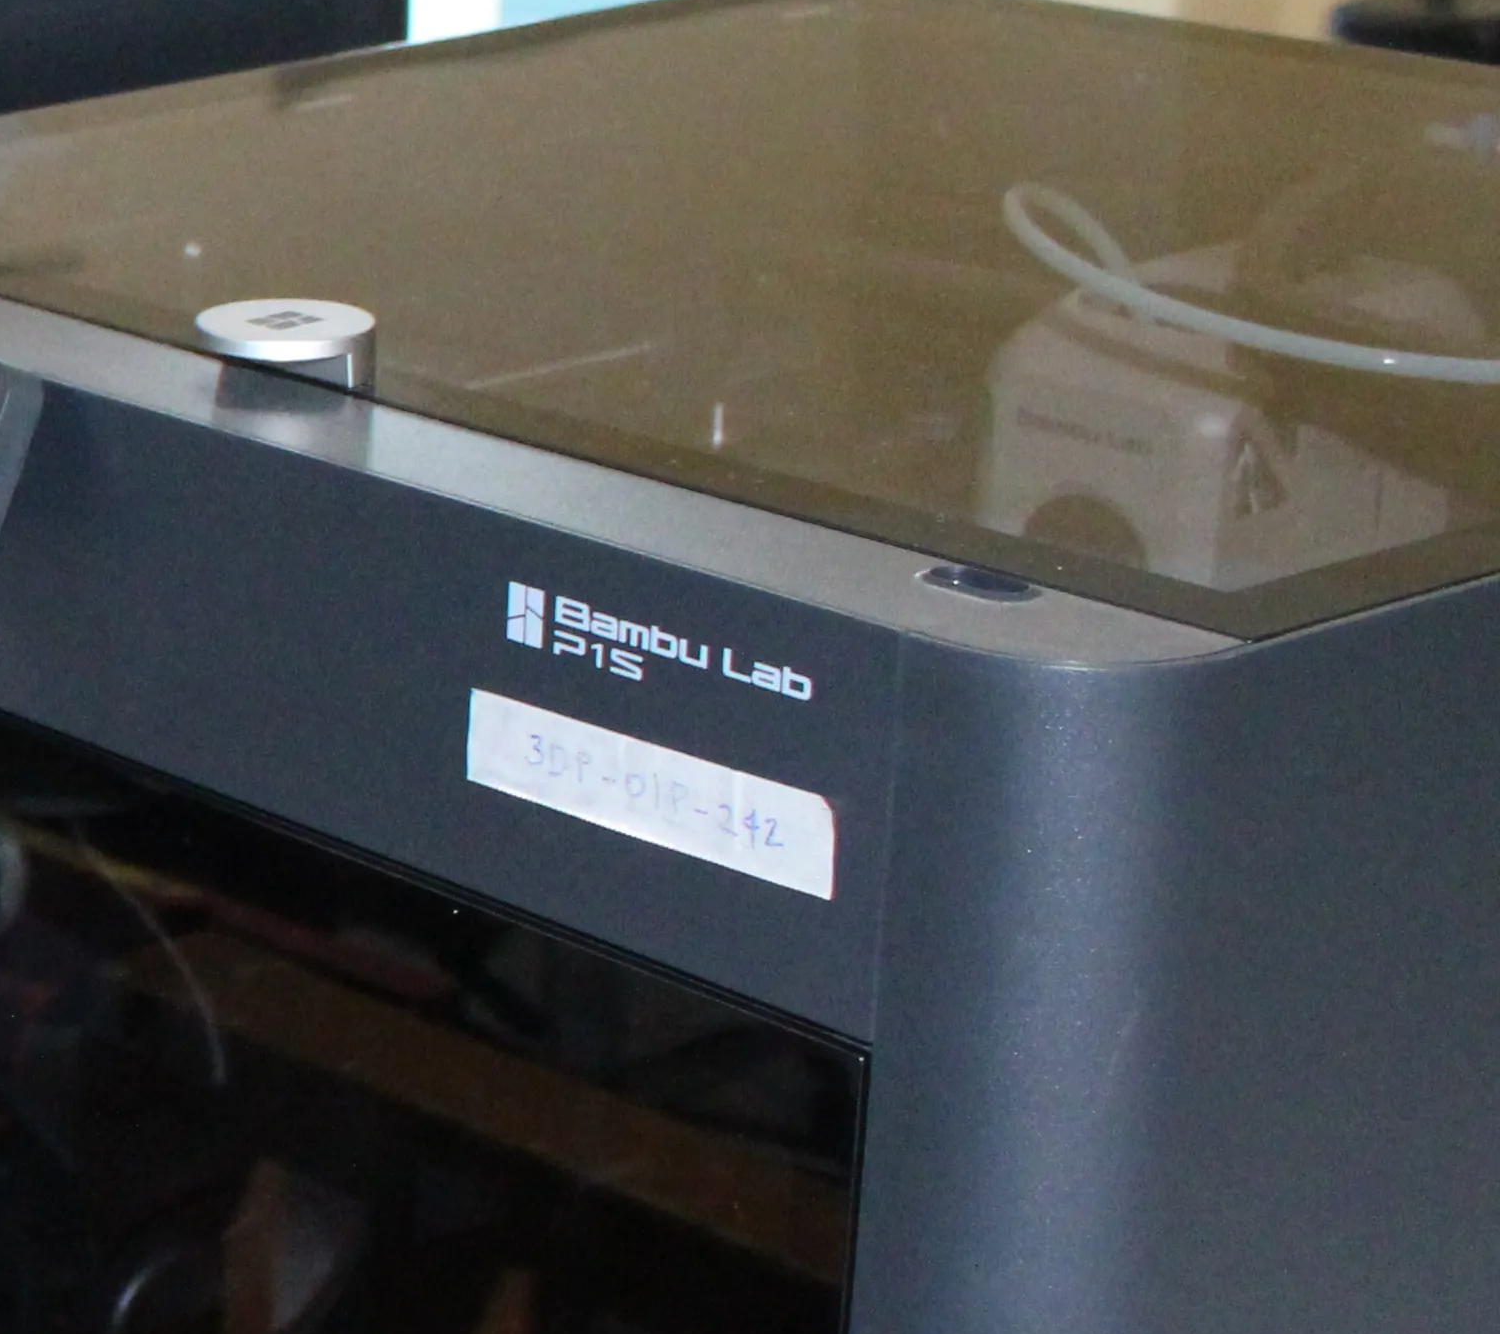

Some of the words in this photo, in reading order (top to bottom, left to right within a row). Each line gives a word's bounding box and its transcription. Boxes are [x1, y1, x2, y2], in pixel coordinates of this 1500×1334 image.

[553, 630, 644, 681] P1S
[554, 595, 709, 670] Bambu
[722, 648, 812, 701] Lab
